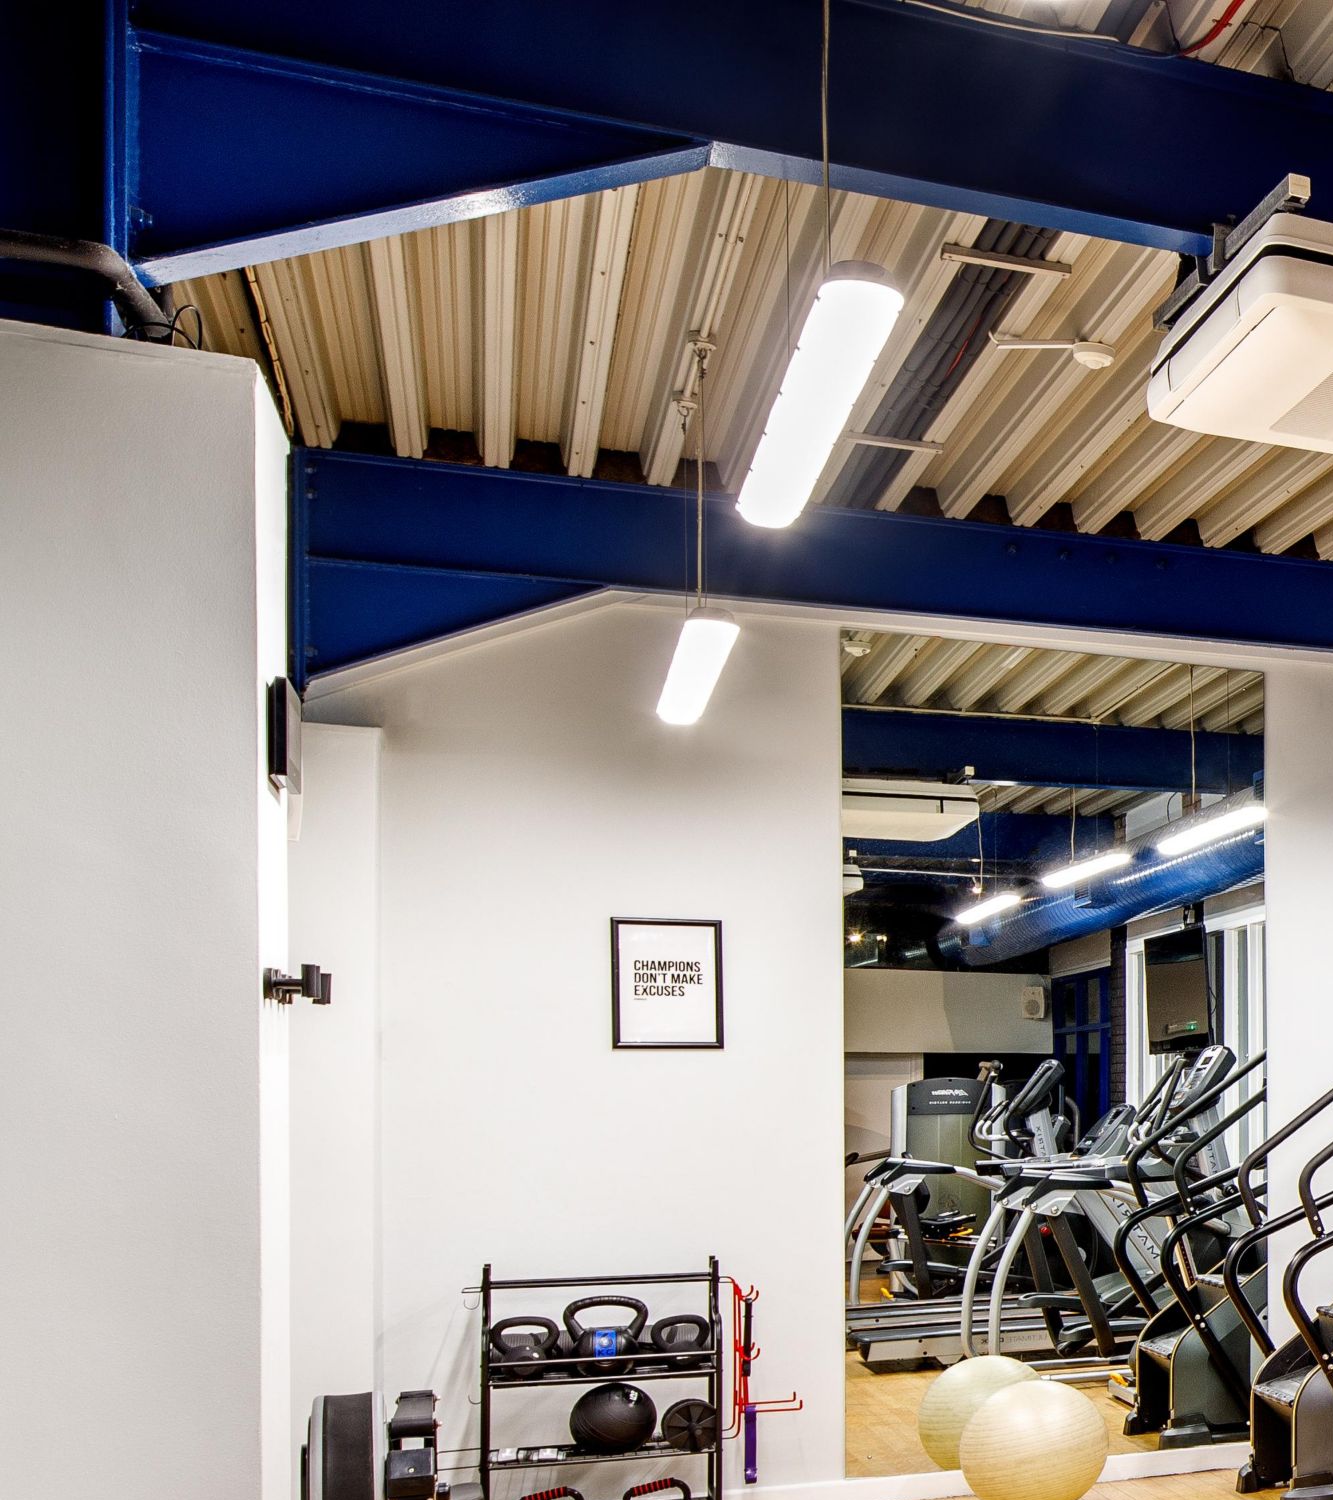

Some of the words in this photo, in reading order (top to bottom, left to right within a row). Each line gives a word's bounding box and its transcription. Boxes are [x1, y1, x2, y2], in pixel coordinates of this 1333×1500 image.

[633, 959, 701, 973] CHAMPIONS
[634, 972, 668, 984] DON'T
[671, 973, 703, 985] MAKE
[634, 985, 685, 997] EXCUSES
